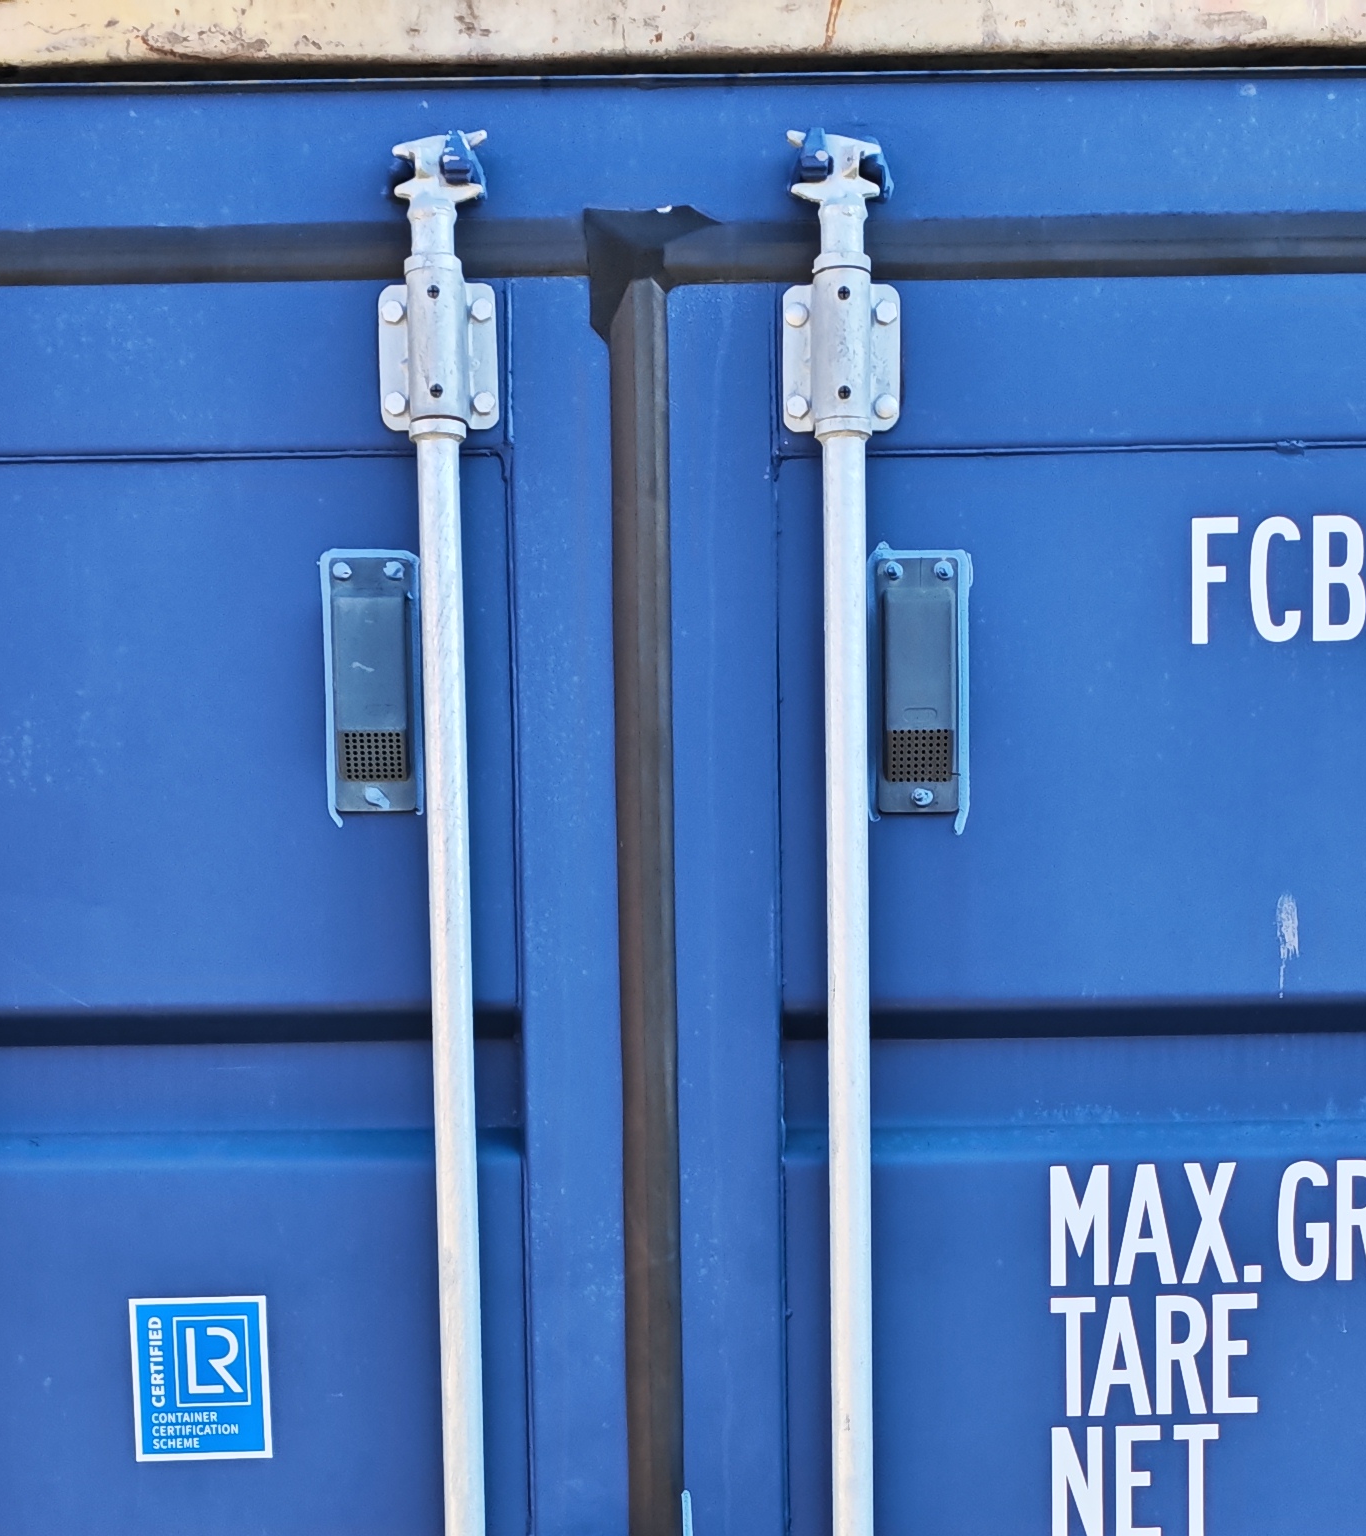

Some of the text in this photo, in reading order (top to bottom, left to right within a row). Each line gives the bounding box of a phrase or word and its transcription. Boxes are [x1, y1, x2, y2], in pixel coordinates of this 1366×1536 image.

[148, 1316, 165, 1408] CERTIFIED
[186, 1326, 244, 1394] LR
[1050, 1293, 1258, 1417] TARE
[151, 1411, 217, 1423] CONTAINER
[152, 1423, 239, 1436] CERTIFICATION
[153, 1437, 200, 1450] SCHEME
